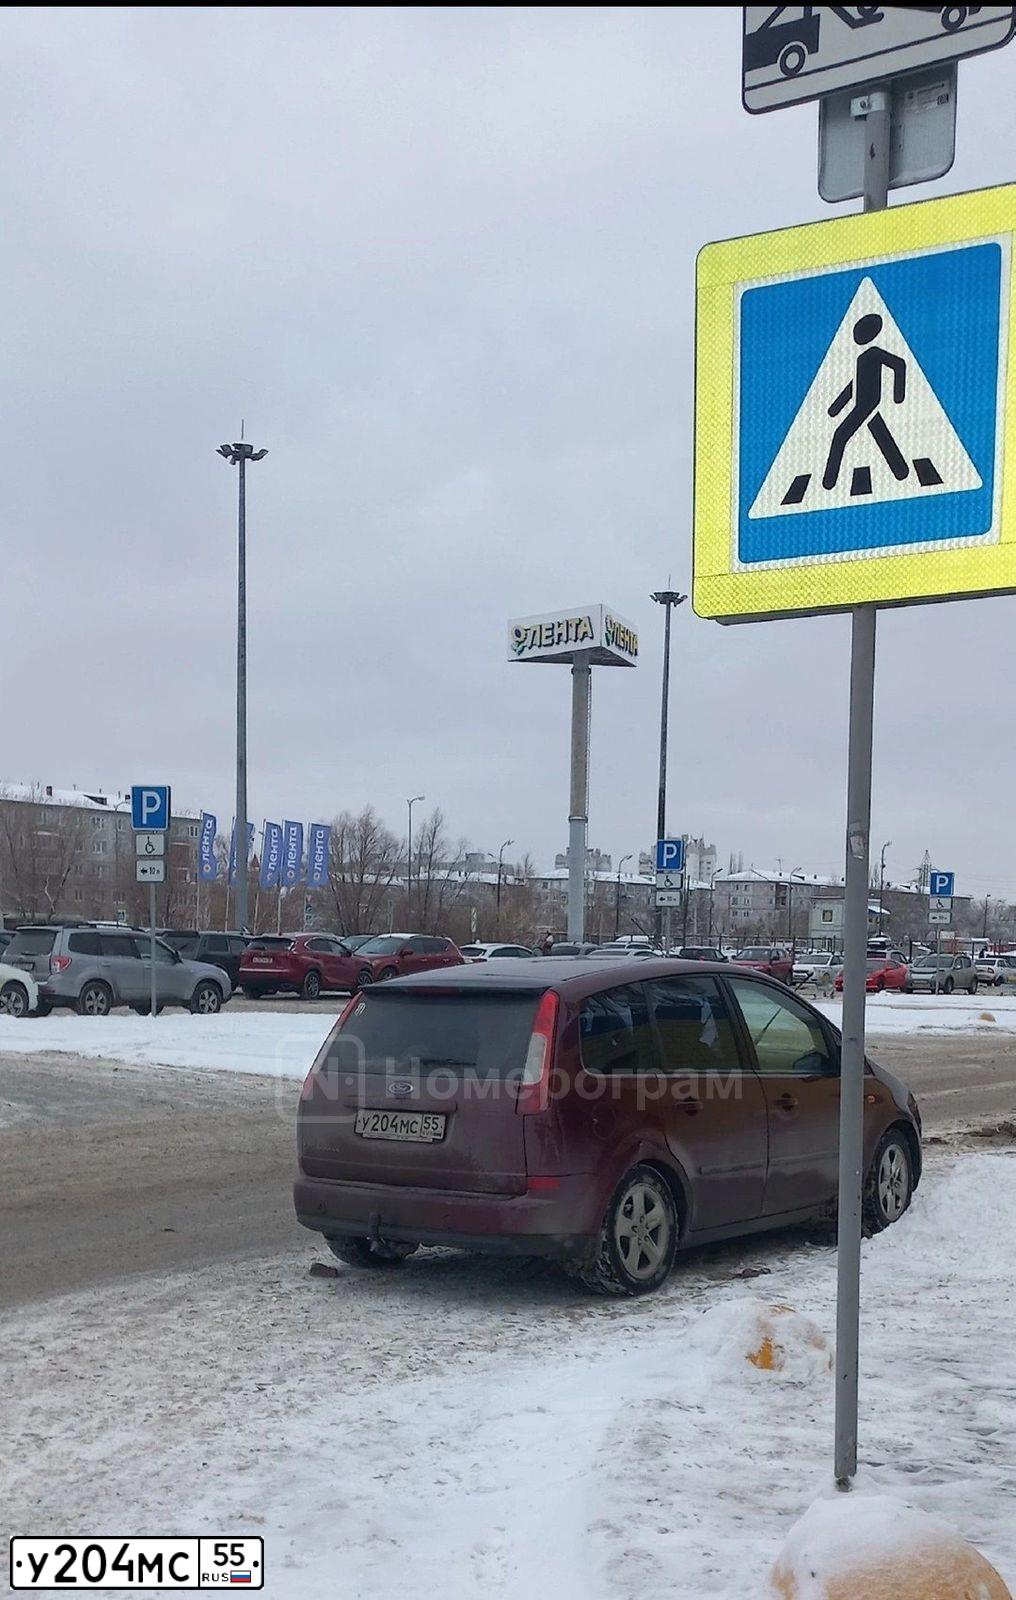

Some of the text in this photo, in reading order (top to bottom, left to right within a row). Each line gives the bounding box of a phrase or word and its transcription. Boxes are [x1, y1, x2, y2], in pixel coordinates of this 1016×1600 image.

[527, 616, 594, 649] ЛЕНТА
[611, 621, 638, 657] ЛЕНТА
[142, 791, 161, 824] P
[202, 819, 213, 862] лента
[268, 828, 278, 871] лента
[287, 826, 297, 869] лента
[313, 829, 324, 872] лента
[663, 843, 677, 867] P
[936, 874, 949, 893] P
[423, 1116, 439, 1130] 55
